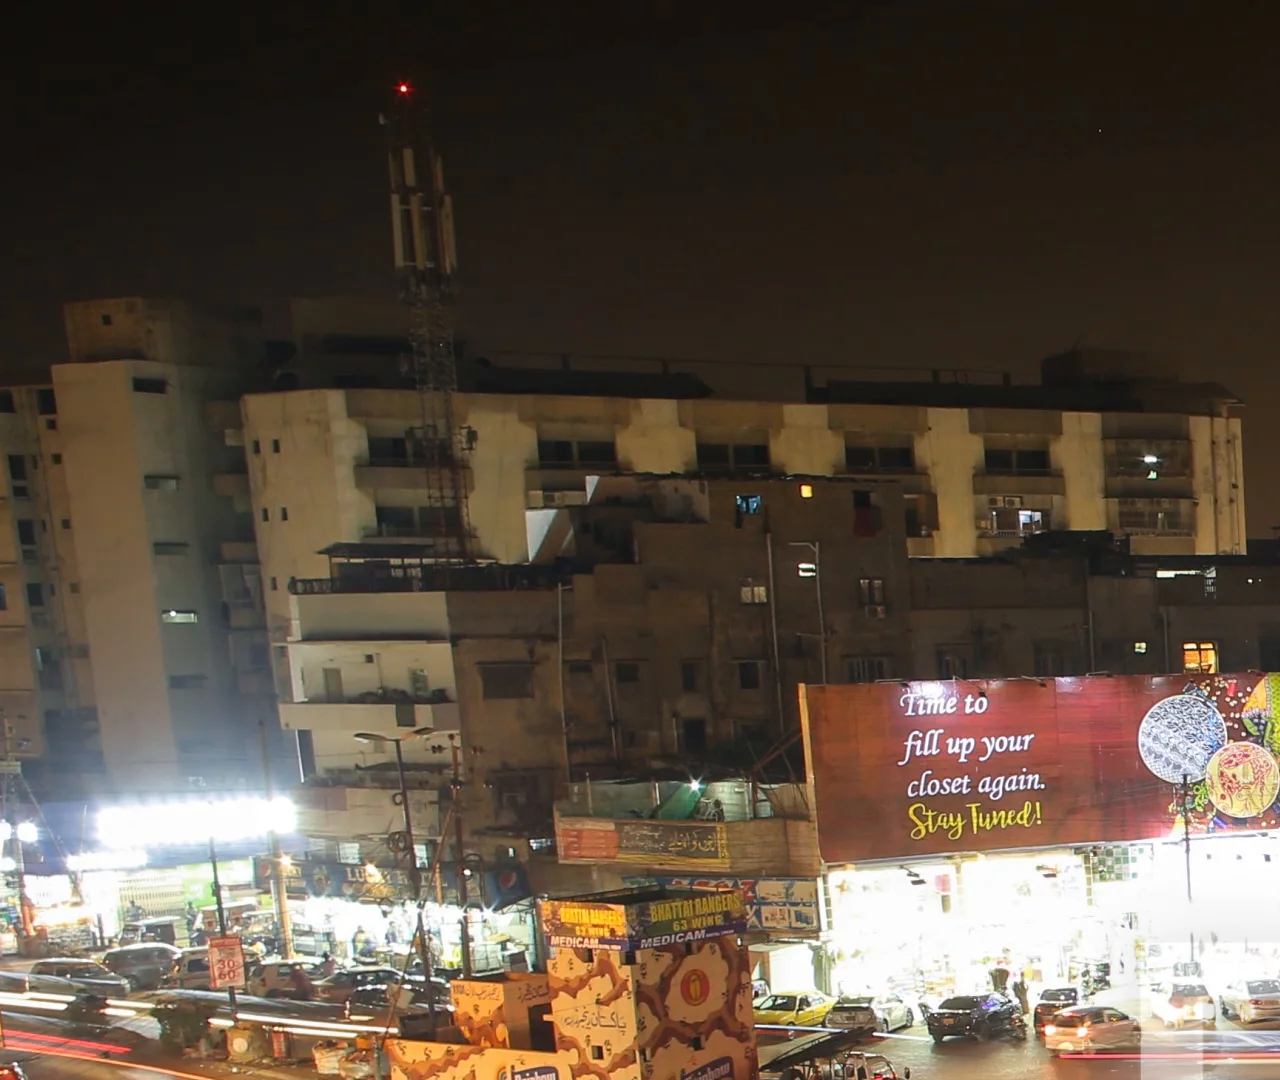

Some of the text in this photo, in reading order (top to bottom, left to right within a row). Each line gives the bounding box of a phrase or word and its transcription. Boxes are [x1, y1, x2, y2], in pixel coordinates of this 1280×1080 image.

[899, 688, 988, 716] Time to
[897, 729, 1035, 766] fill up your
[907, 768, 1045, 800] closet again.
[908, 801, 1042, 840] Stay Tuned!
[673, 915, 723, 931] 63 WING
[550, 936, 599, 949] MEDICAM
[640, 929, 705, 949] MEDICAM
